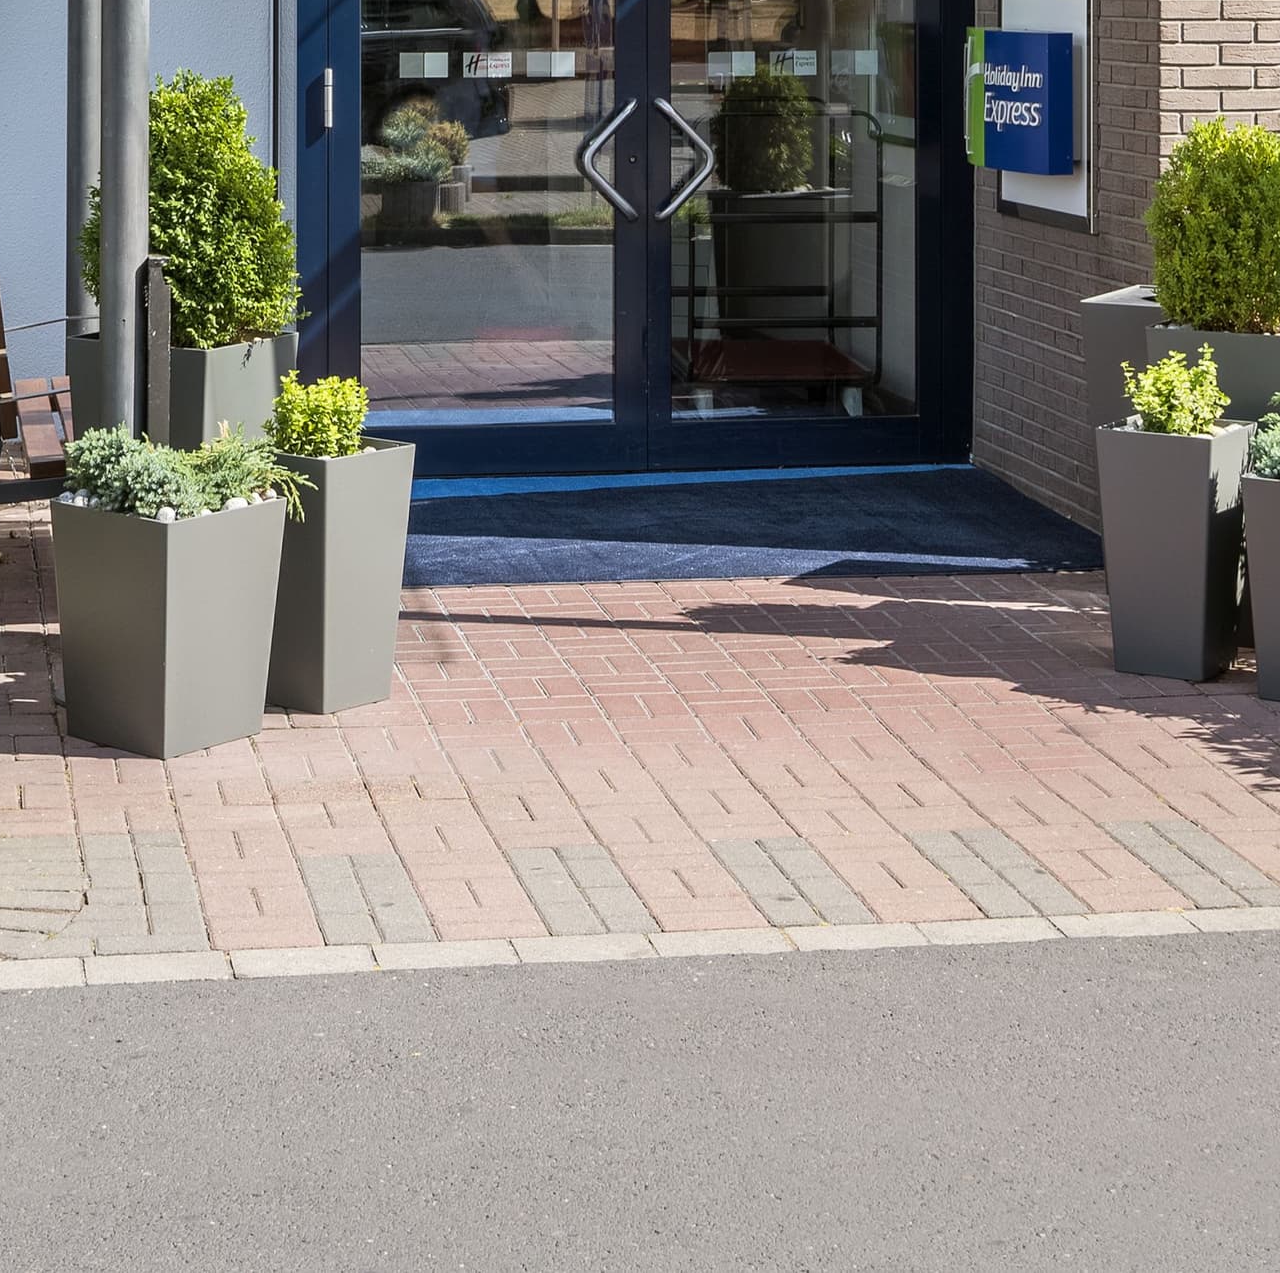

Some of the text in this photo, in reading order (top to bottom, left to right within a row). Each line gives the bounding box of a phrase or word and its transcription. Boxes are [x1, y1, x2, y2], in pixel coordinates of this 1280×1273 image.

[984, 62, 1044, 92] Holiday Inn
[984, 92, 1042, 132] Express
